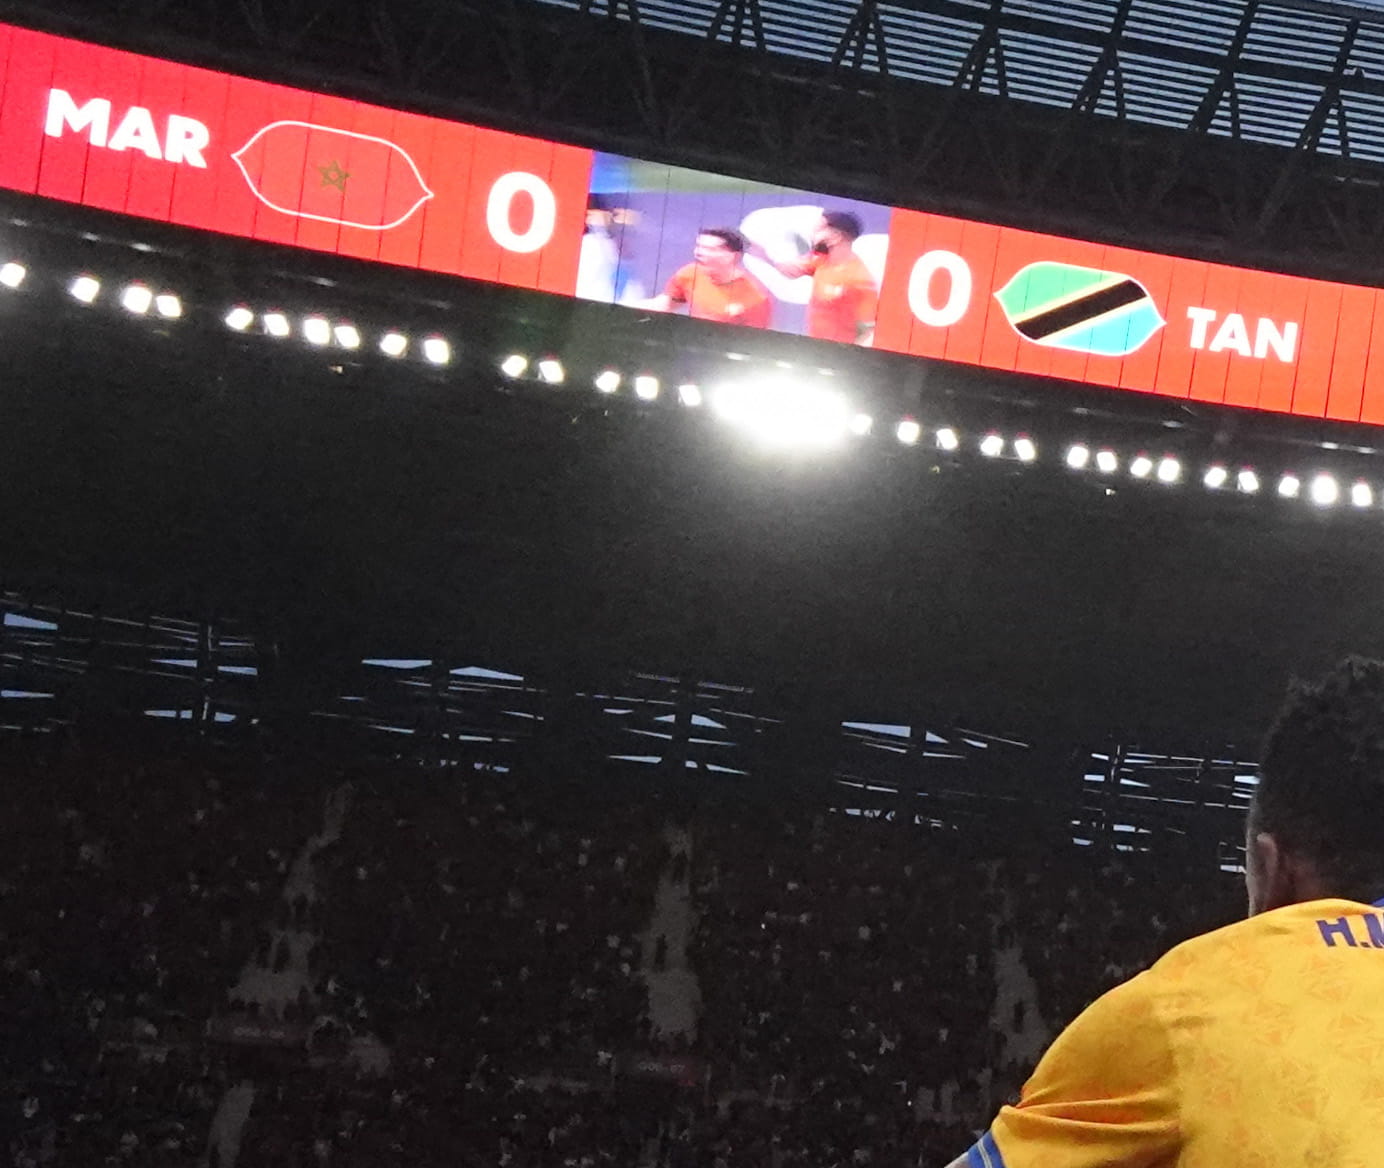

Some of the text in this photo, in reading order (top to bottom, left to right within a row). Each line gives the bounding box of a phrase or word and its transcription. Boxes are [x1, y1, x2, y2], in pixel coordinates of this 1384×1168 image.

[44, 88, 1300, 364] MAR 0 0 TAN
